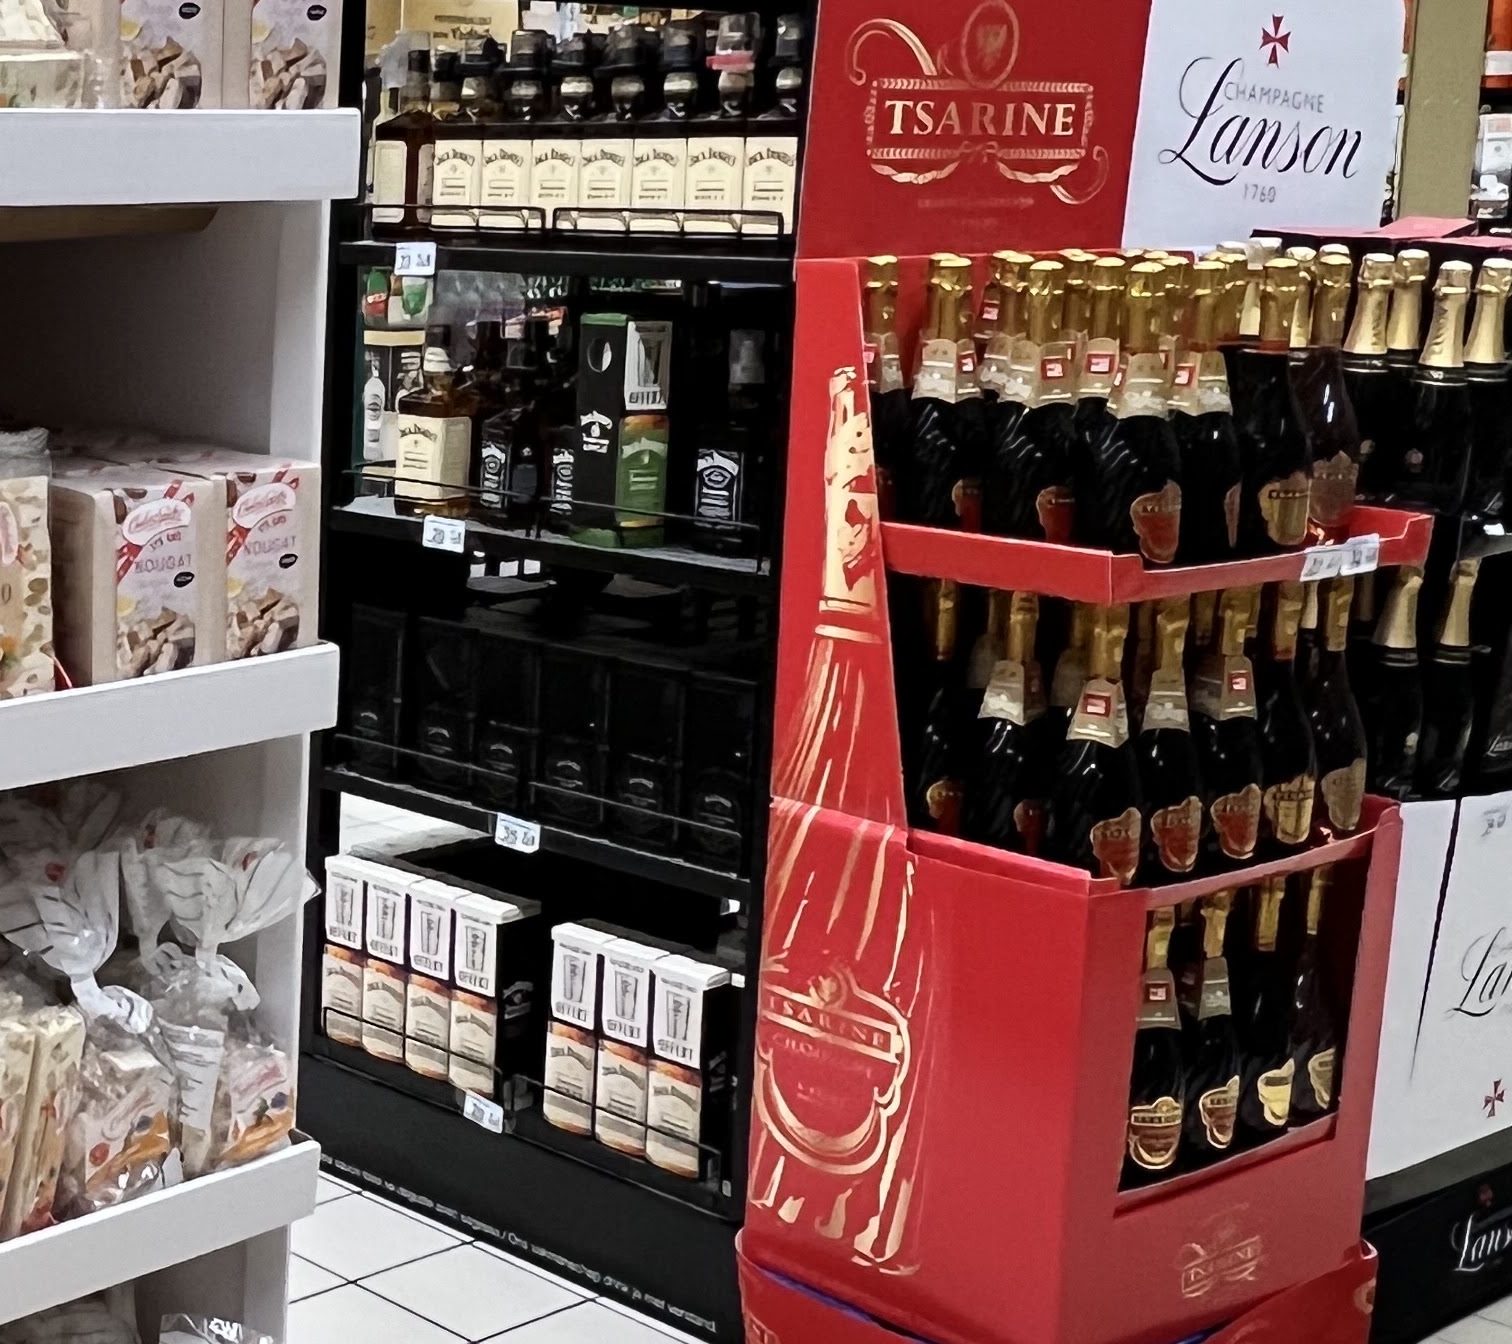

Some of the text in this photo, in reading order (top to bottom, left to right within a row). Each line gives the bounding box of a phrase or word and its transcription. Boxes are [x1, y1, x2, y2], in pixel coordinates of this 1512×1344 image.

[1224, 81, 1324, 114] CHAMPAGNE
[884, 99, 1076, 137] TSARINE
[1158, 56, 1362, 186] Lanson
